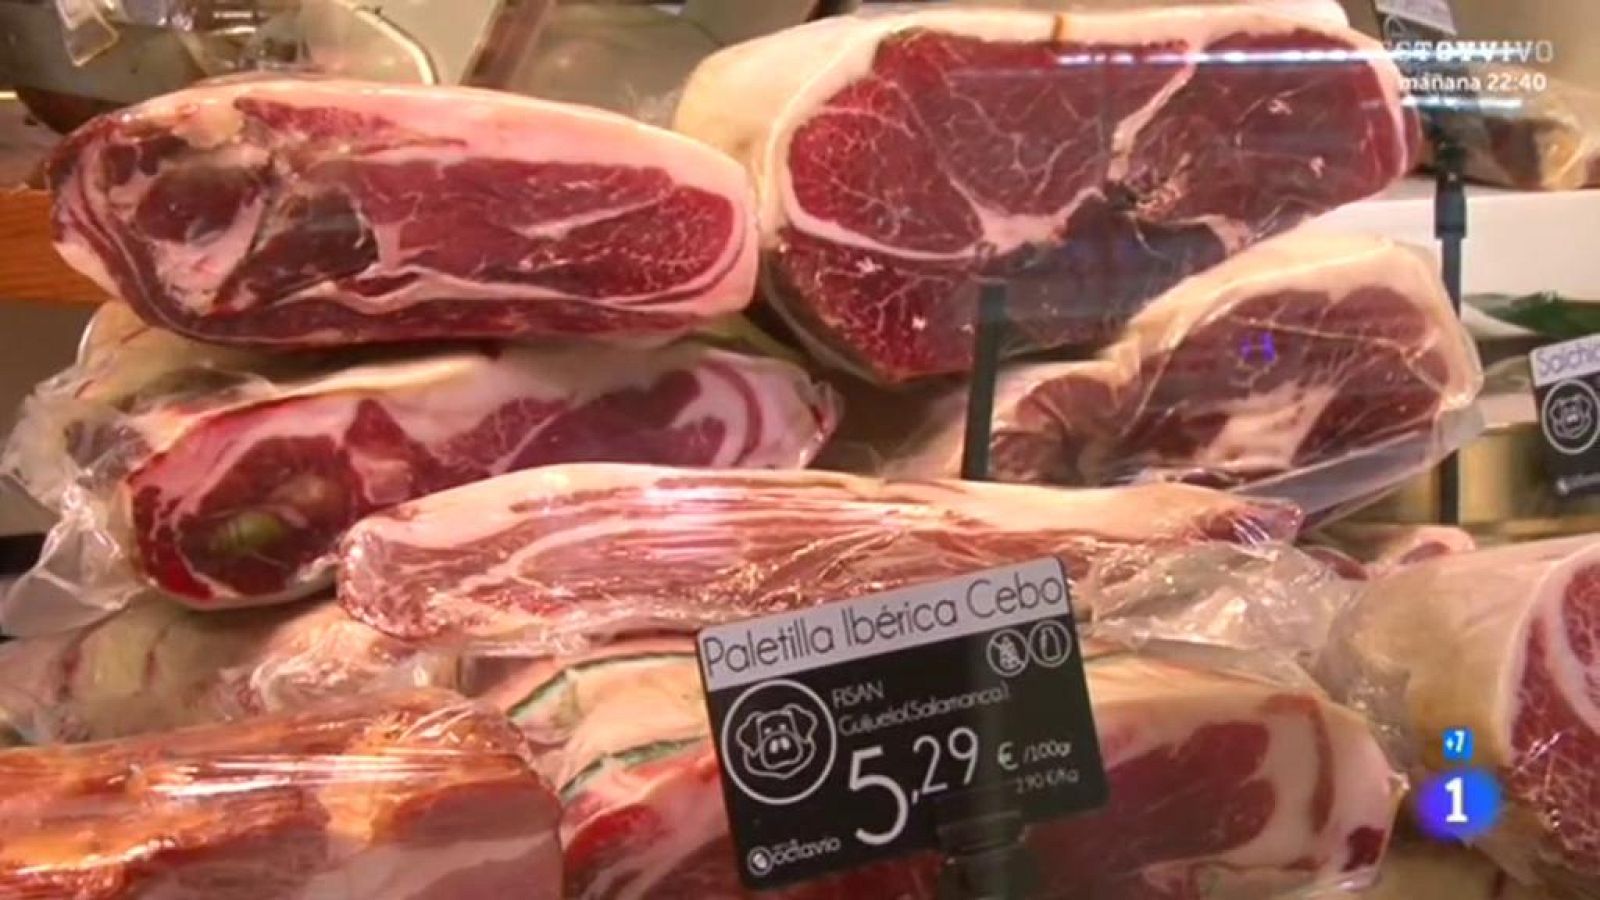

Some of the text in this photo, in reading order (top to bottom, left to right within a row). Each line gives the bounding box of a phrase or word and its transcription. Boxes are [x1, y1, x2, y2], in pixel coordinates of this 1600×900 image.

[702, 574, 1064, 677] Paletilla Ibérica Cebo
